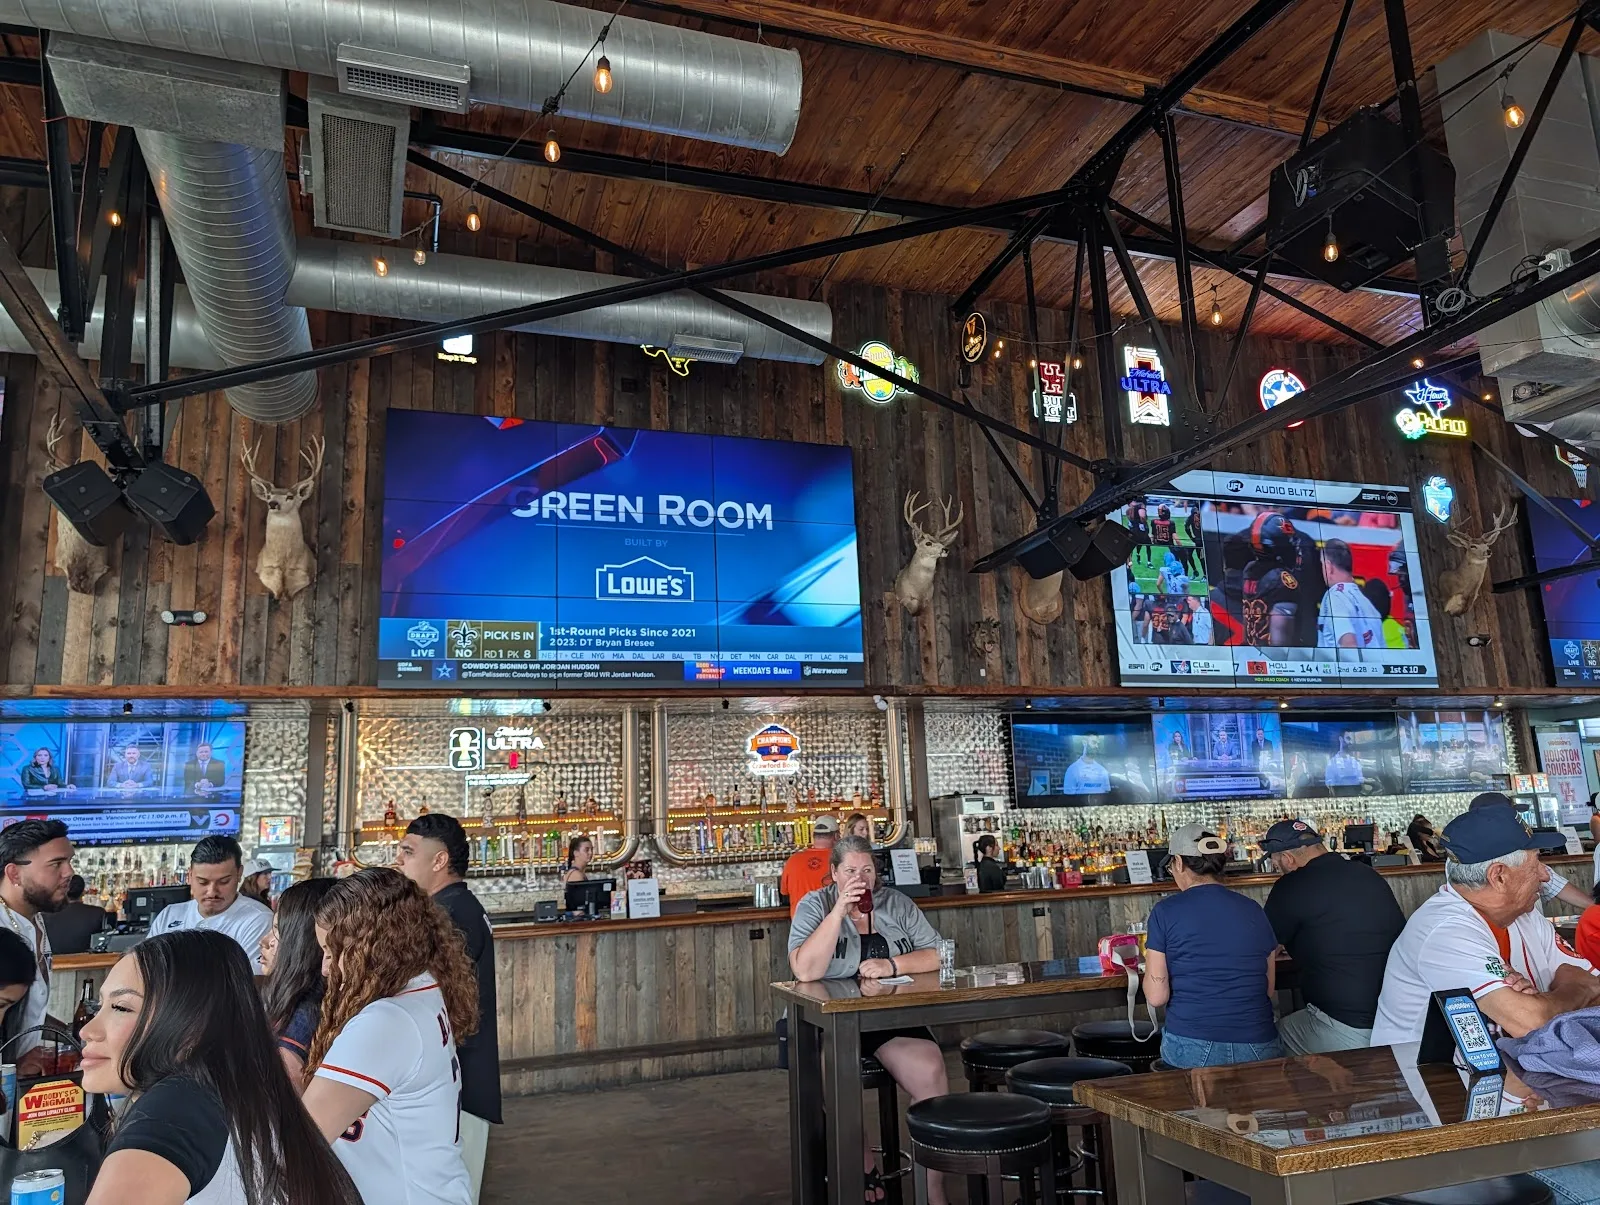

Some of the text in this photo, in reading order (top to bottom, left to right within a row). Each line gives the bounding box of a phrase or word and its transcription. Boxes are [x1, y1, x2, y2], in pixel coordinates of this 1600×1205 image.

[1120, 377, 1172, 395] ULTRA
[1226, 480, 1315, 498] UFL AUDIO BLITZ
[1362, 493, 1381, 501] ESPN
[511, 487, 773, 531] GREEN ROOM
[624, 538, 668, 548] BUILT BY
[607, 572, 686, 597] LOWE'S
[411, 631, 437, 639] DRAFT
[484, 630, 535, 643] PICK IS IN
[550, 626, 696, 638] 1st-Round Picks Since 2021
[550, 638, 655, 649] 2023: DT Bryan Bresee
[411, 649, 436, 658] LIVE
[455, 650, 473, 658] NO
[484, 649, 532, 659] RD 1 PK 8
[571, 652, 584, 660] CLE
[591, 652, 605, 660] NYG
[612, 652, 625, 660] MIA
[632, 652, 646, 660] DAL
[652, 652, 665, 660] LAR
[671, 652, 685, 660] BAL
[693, 652, 702, 660] TB
[710, 653, 724, 661] NYJ
[730, 653, 743, 661] DET
[749, 653, 761, 661] MIN
[766, 653, 779, 661] CAR
[785, 653, 797, 661] DAL
[804, 653, 813, 661] PIT
[820, 653, 832, 661] LAC
[839, 653, 848, 661] PHI
[462, 662, 600, 671] COWBOYS SIGNING WR JORDAN HUDSON
[733, 666, 771, 675] WEEKDAYS
[1300, 664, 1312, 673] 14
[1389, 665, 1401, 674] 1st
[1402, 666, 1409, 674] &
[1409, 666, 1418, 674] 10
[512, 671, 540, 680] Cowboys
[611, 672, 631, 680] Jordan
[486, 735, 546, 751] ULTRA
[756, 736, 792, 745] CHAMPIONS
[1543, 748, 1580, 763] HOUSTON
[1546, 761, 1582, 776] COUGARS
[27, 1111, 38, 1119] JOIN
[38, 1110, 47, 1118] OUR
[47, 1108, 64, 1117] LOYALTY
